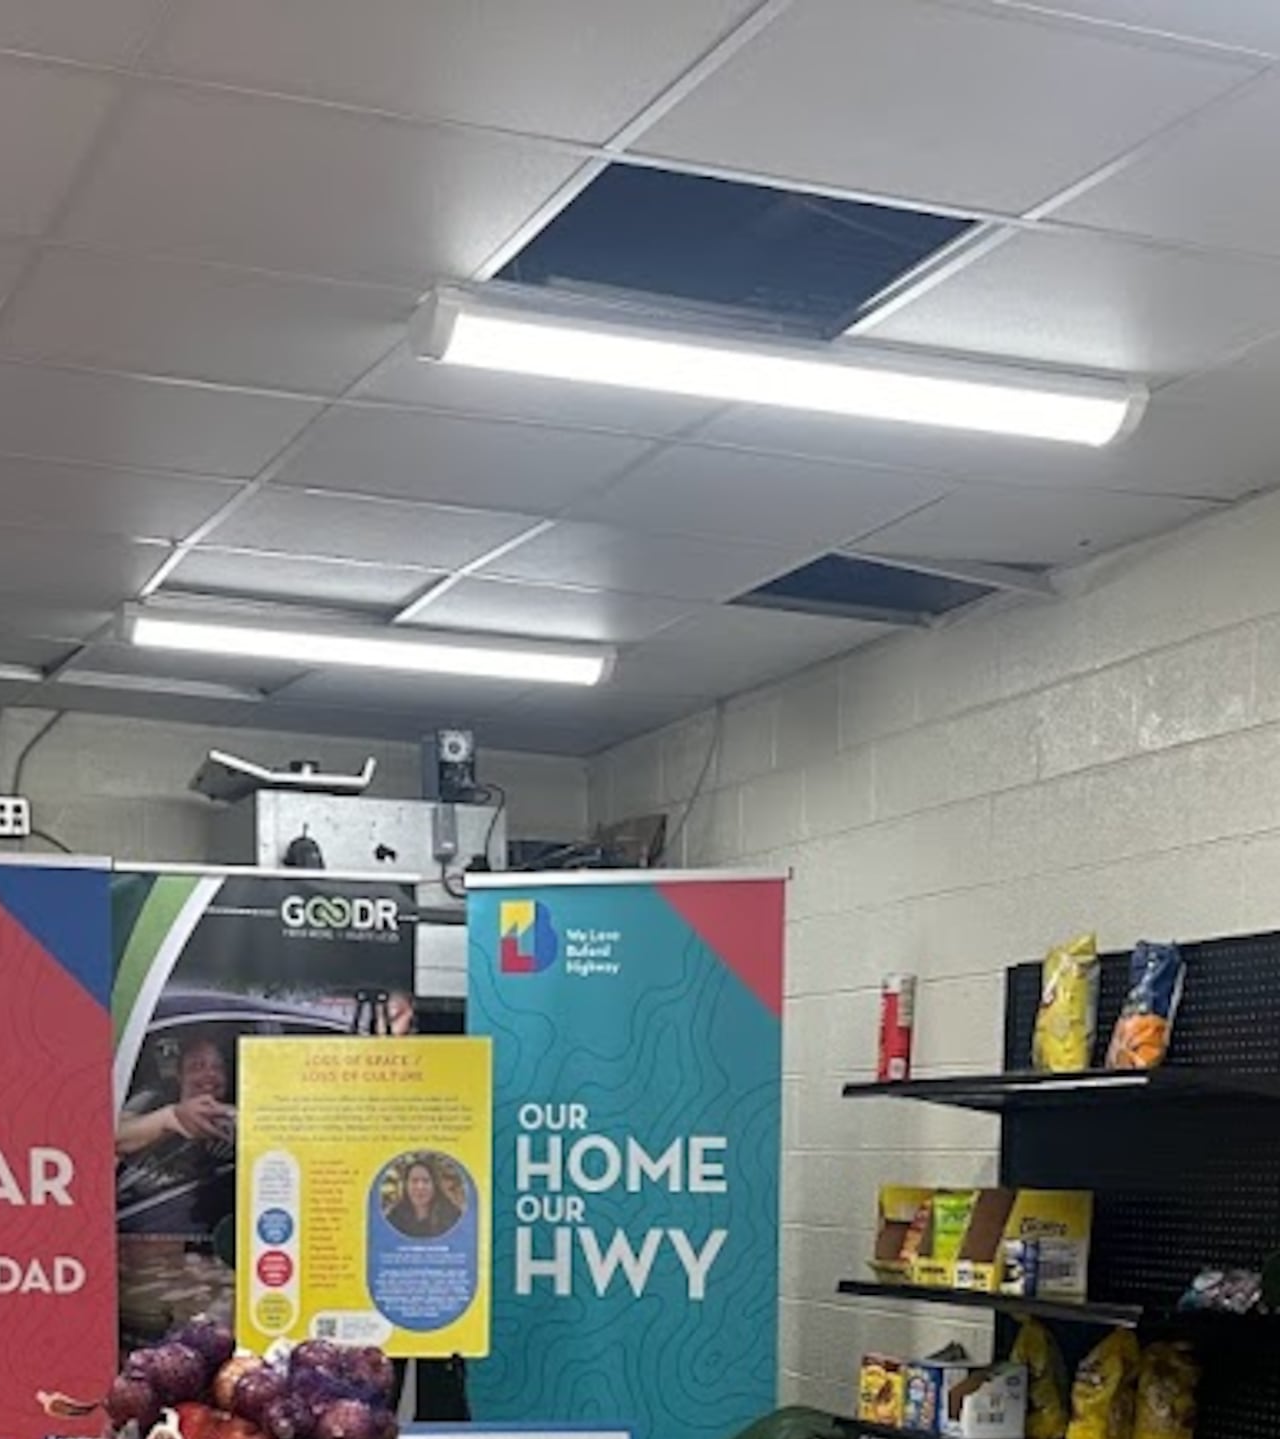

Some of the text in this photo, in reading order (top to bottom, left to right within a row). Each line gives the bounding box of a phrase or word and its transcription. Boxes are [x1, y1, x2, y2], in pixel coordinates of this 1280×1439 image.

[282, 895, 399, 931] GOODR
[566, 928, 621, 942] We Love
[566, 943, 611, 957] Buford
[566, 959, 621, 976] Highway
[305, 1055, 340, 1066] LOSS
[344, 1055, 361, 1066] OF
[366, 1055, 409, 1066] SPACE
[301, 1071, 425, 1083] LOSS OF CULTURE
[519, 1103, 588, 1131] OUR
[517, 1134, 728, 1194] HOME
[516, 1195, 586, 1223] OUR
[516, 1225, 729, 1300] HWY
